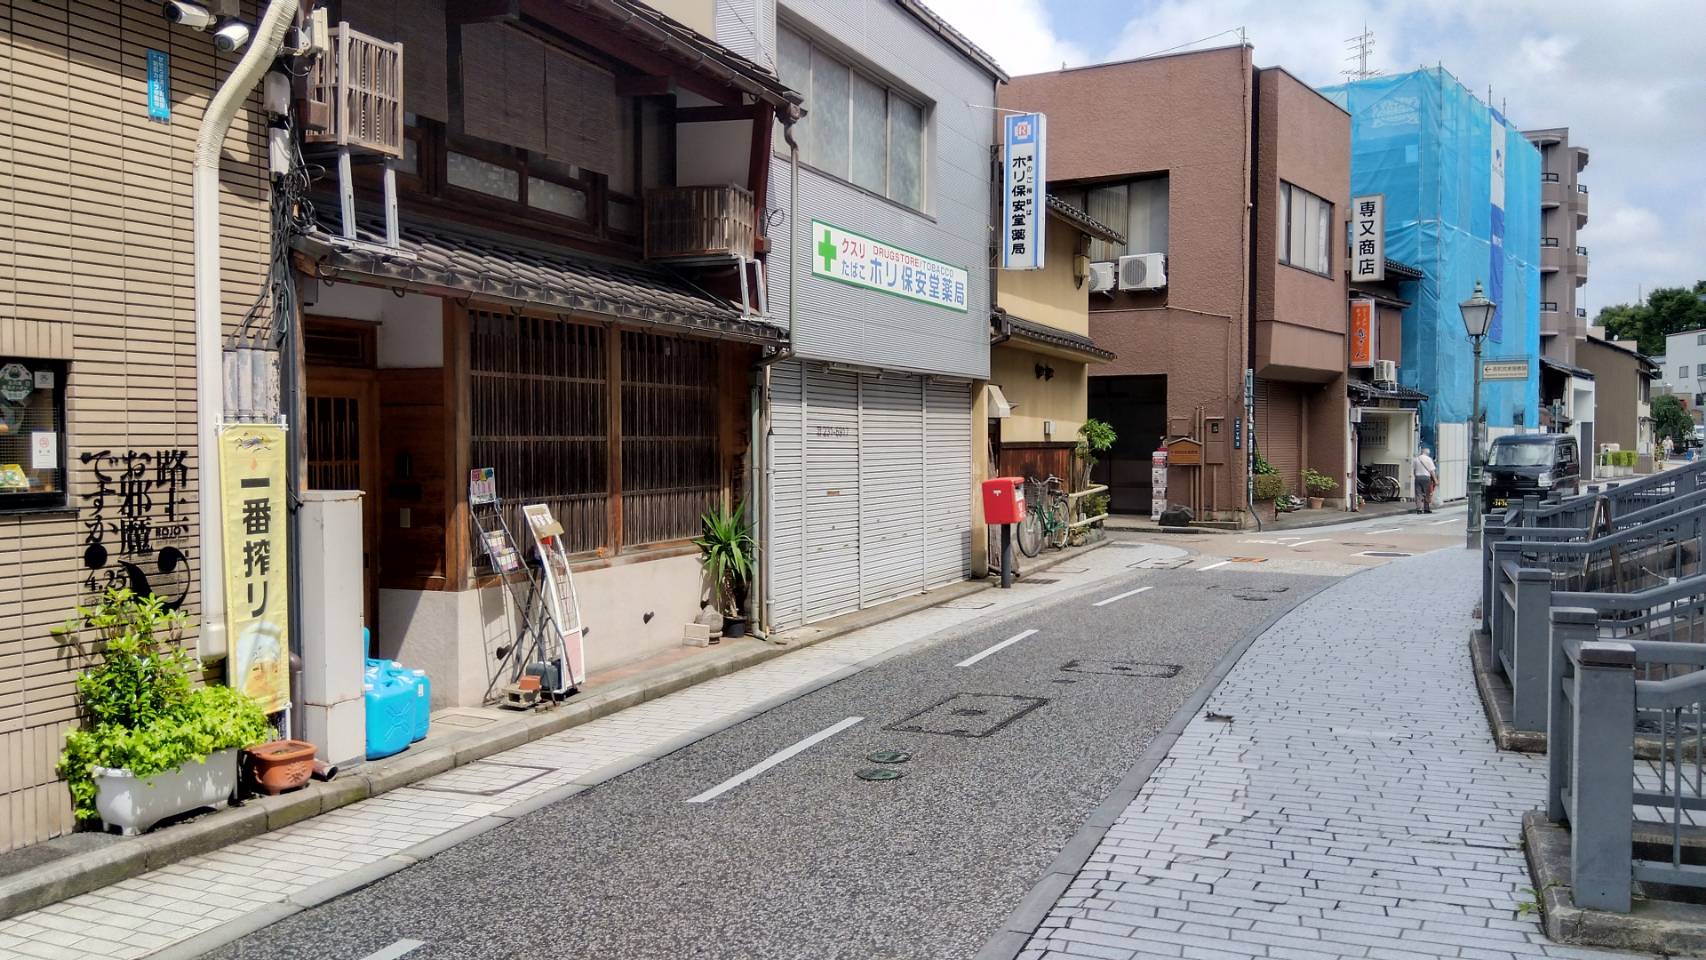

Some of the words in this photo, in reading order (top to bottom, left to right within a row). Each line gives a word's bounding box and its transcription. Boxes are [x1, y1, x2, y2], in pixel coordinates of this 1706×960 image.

[842, 238, 866, 259] クスリ
[1011, 156, 1026, 256] ホリ保安堂薬局
[1358, 201, 1376, 276] 専又商店
[842, 259, 866, 281] たばこ
[870, 257, 965, 305] ホリ保安堂薬局
[118, 449, 154, 556] お邪魔
[240, 476, 272, 618] 一番搾り
